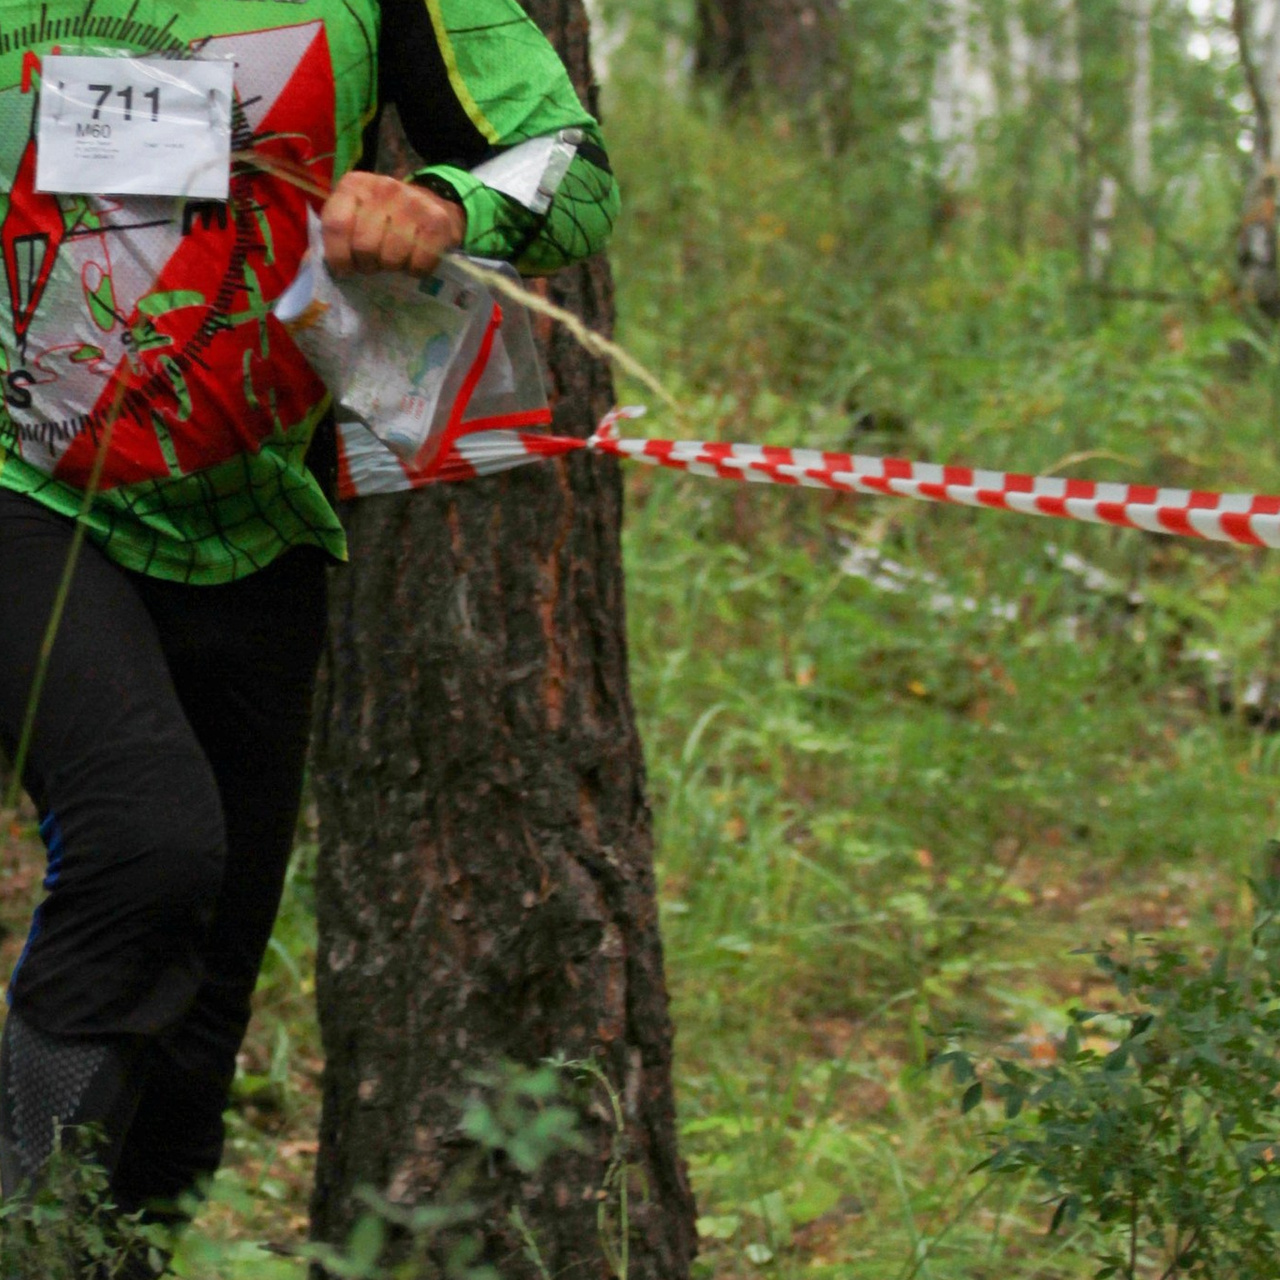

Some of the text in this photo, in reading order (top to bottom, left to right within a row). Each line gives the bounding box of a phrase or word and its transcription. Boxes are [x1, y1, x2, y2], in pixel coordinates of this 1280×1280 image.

[88, 84, 160, 122] 711
[75, 123, 112, 139] M60
[5, 369, 37, 408] S
